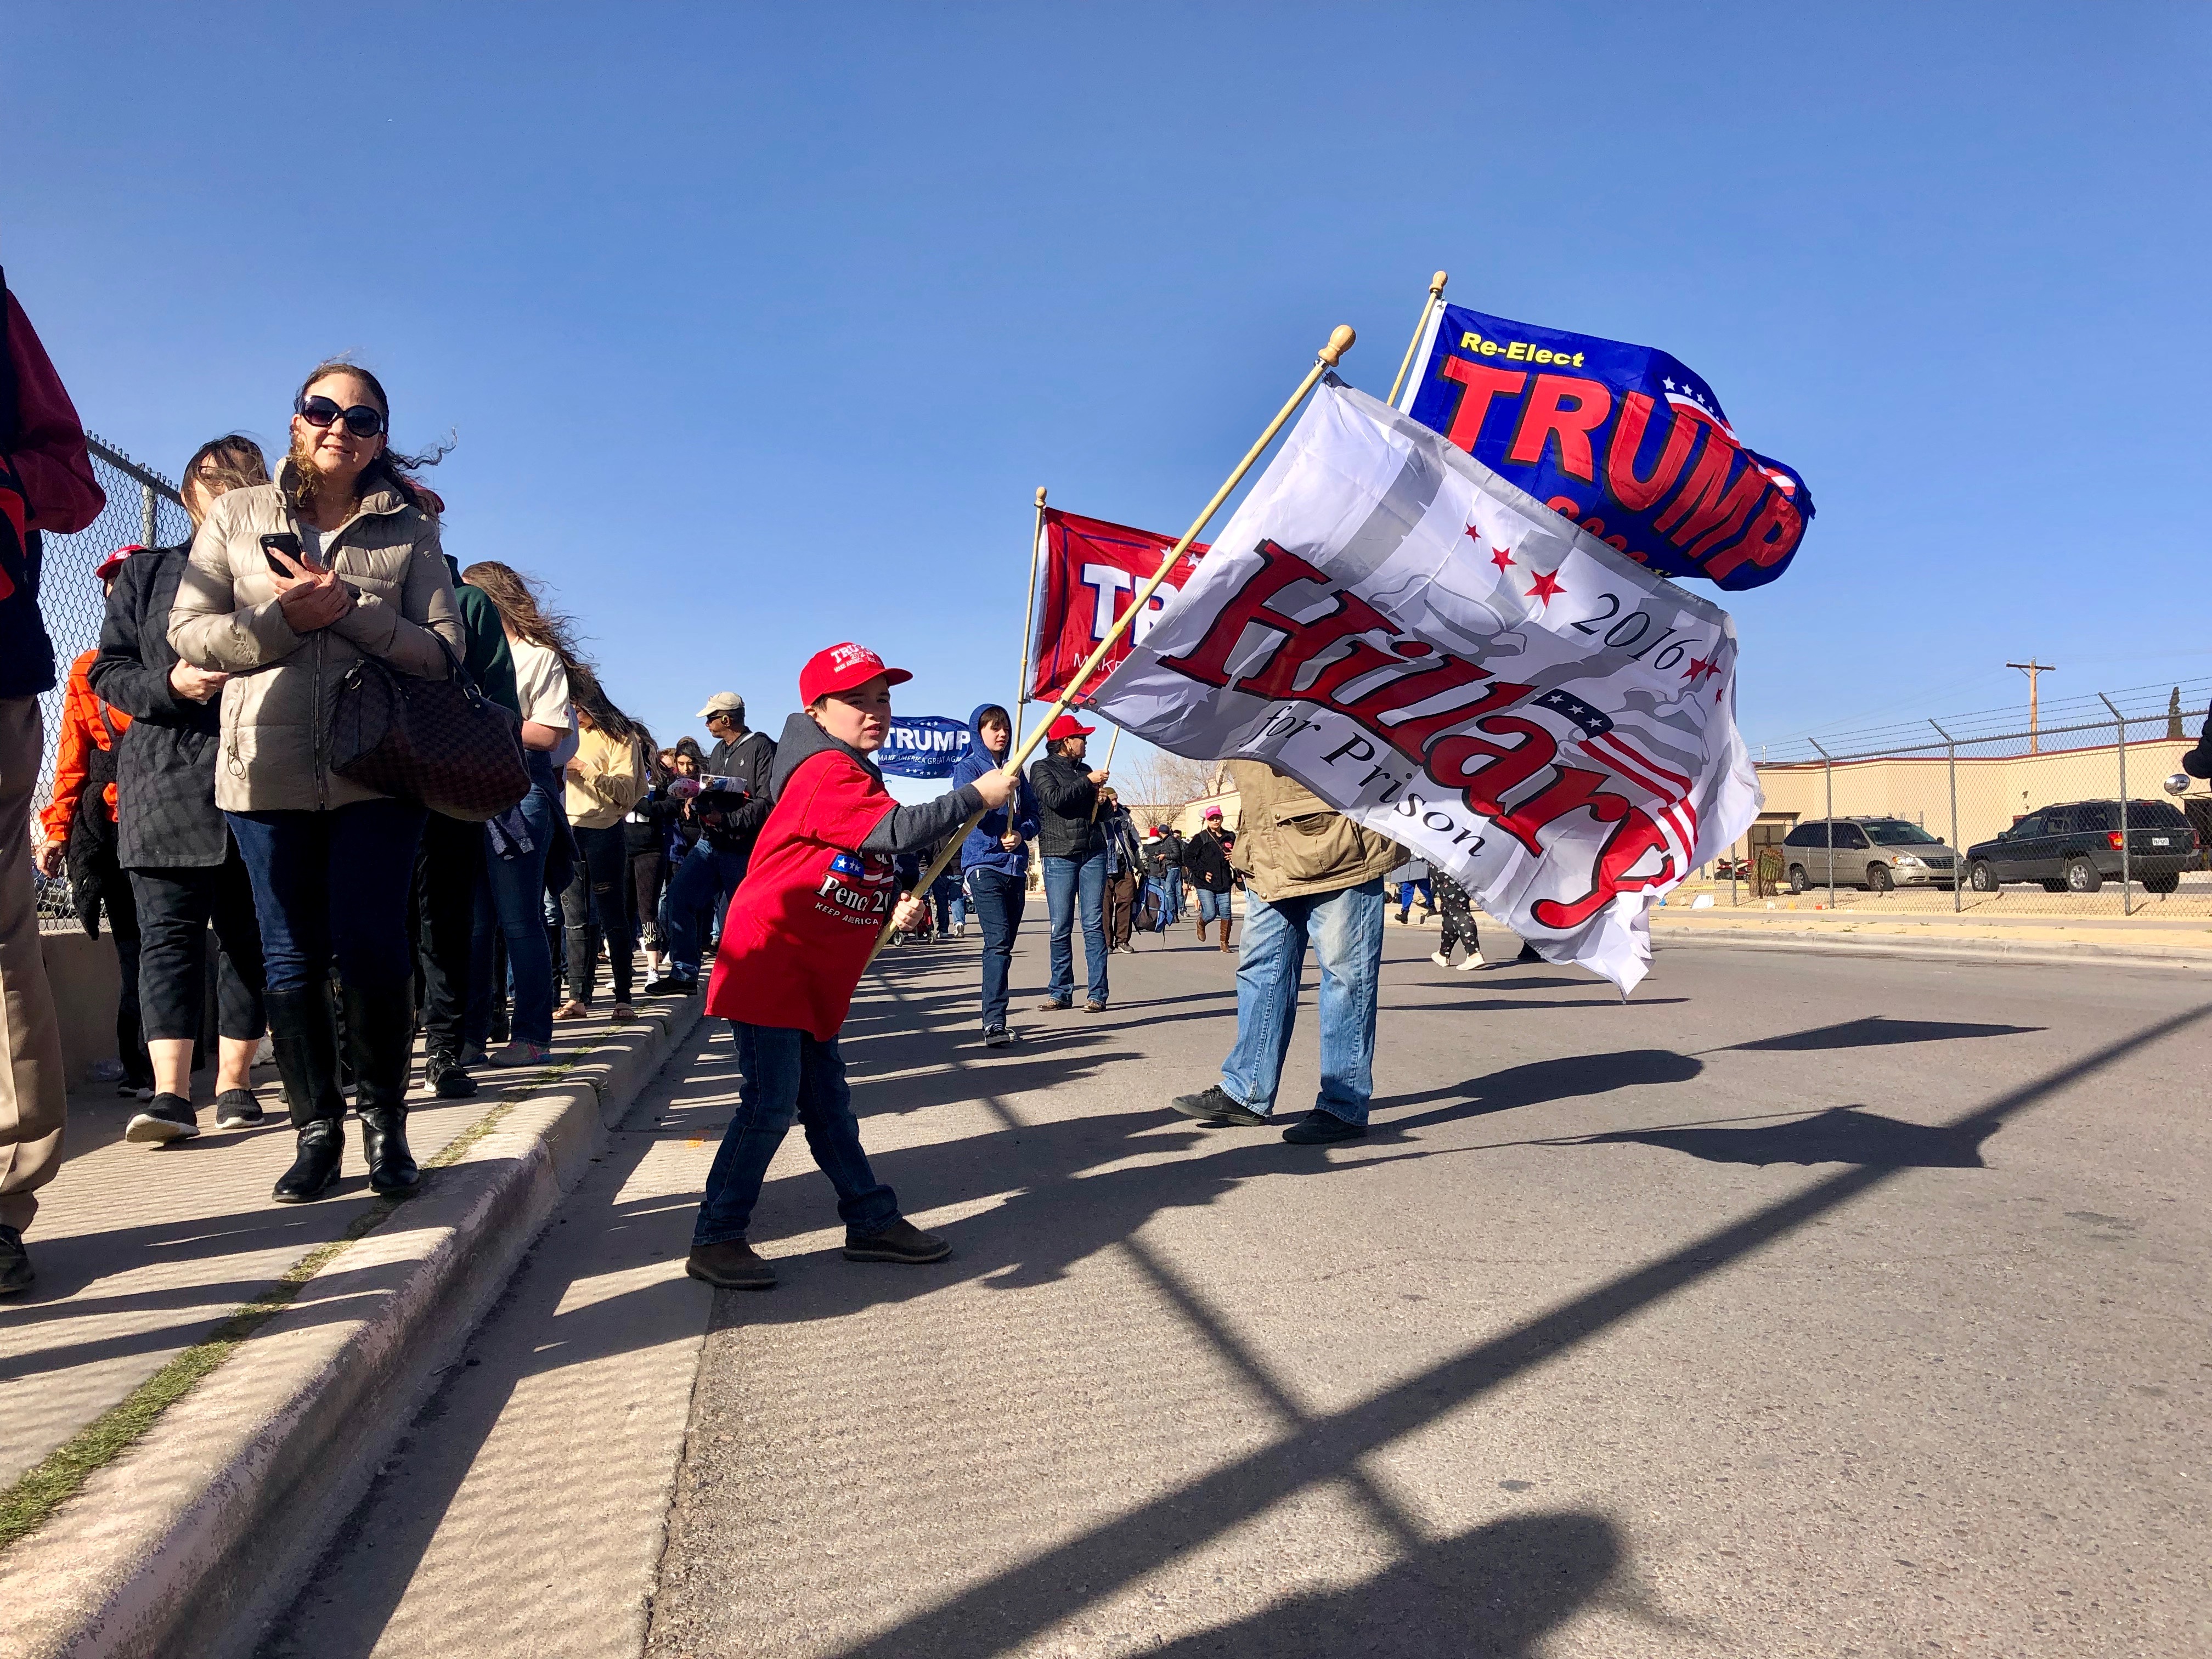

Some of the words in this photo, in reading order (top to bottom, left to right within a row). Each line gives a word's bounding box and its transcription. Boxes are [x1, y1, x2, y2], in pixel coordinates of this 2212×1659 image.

[1460, 331, 1585, 367] Re-Elect
[1443, 354, 1803, 582] TRUMP
[1570, 593, 1703, 670] 2016
[884, 727, 970, 751] TRUMP
[1155, 539, 1675, 930] Hillary
[896, 755, 926, 764] AMERICA
[927, 756, 945, 765] GREAT
[1239, 705, 1321, 747] for
[1320, 732, 1486, 857] Prison
[815, 902, 840, 916] KEEP
[816, 874, 869, 911] Penc
